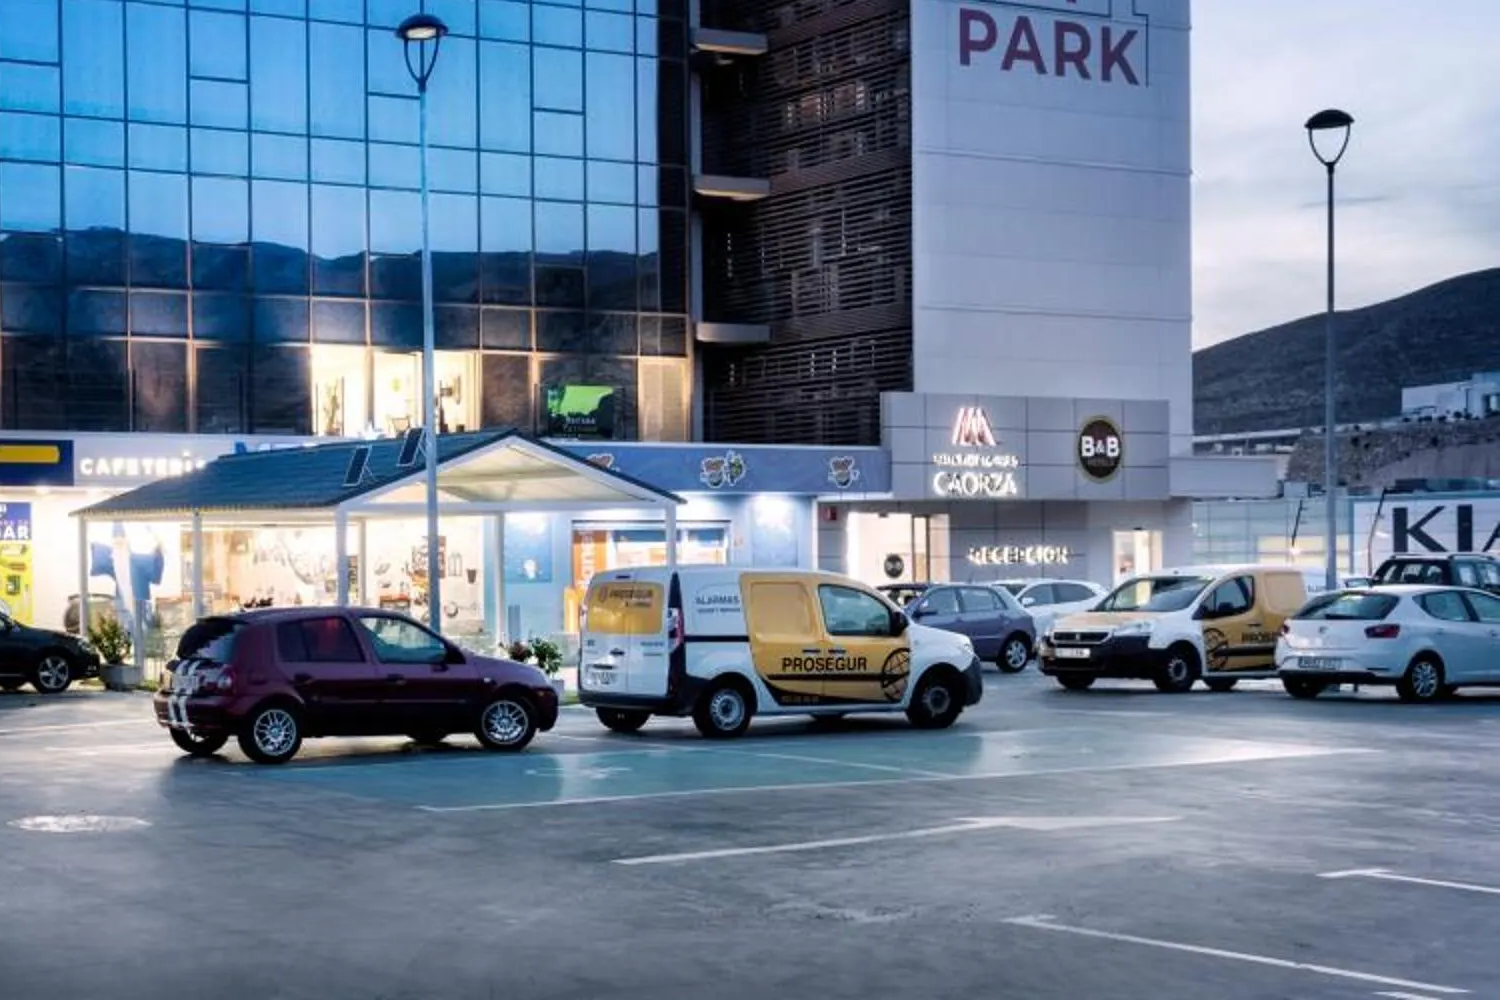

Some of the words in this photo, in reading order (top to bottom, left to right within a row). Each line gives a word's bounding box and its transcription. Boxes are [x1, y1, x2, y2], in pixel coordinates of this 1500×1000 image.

[959, 8, 1140, 87] PARK
[1081, 435, 1120, 457] B&B
[781, 655, 868, 672] PROSEGUR
